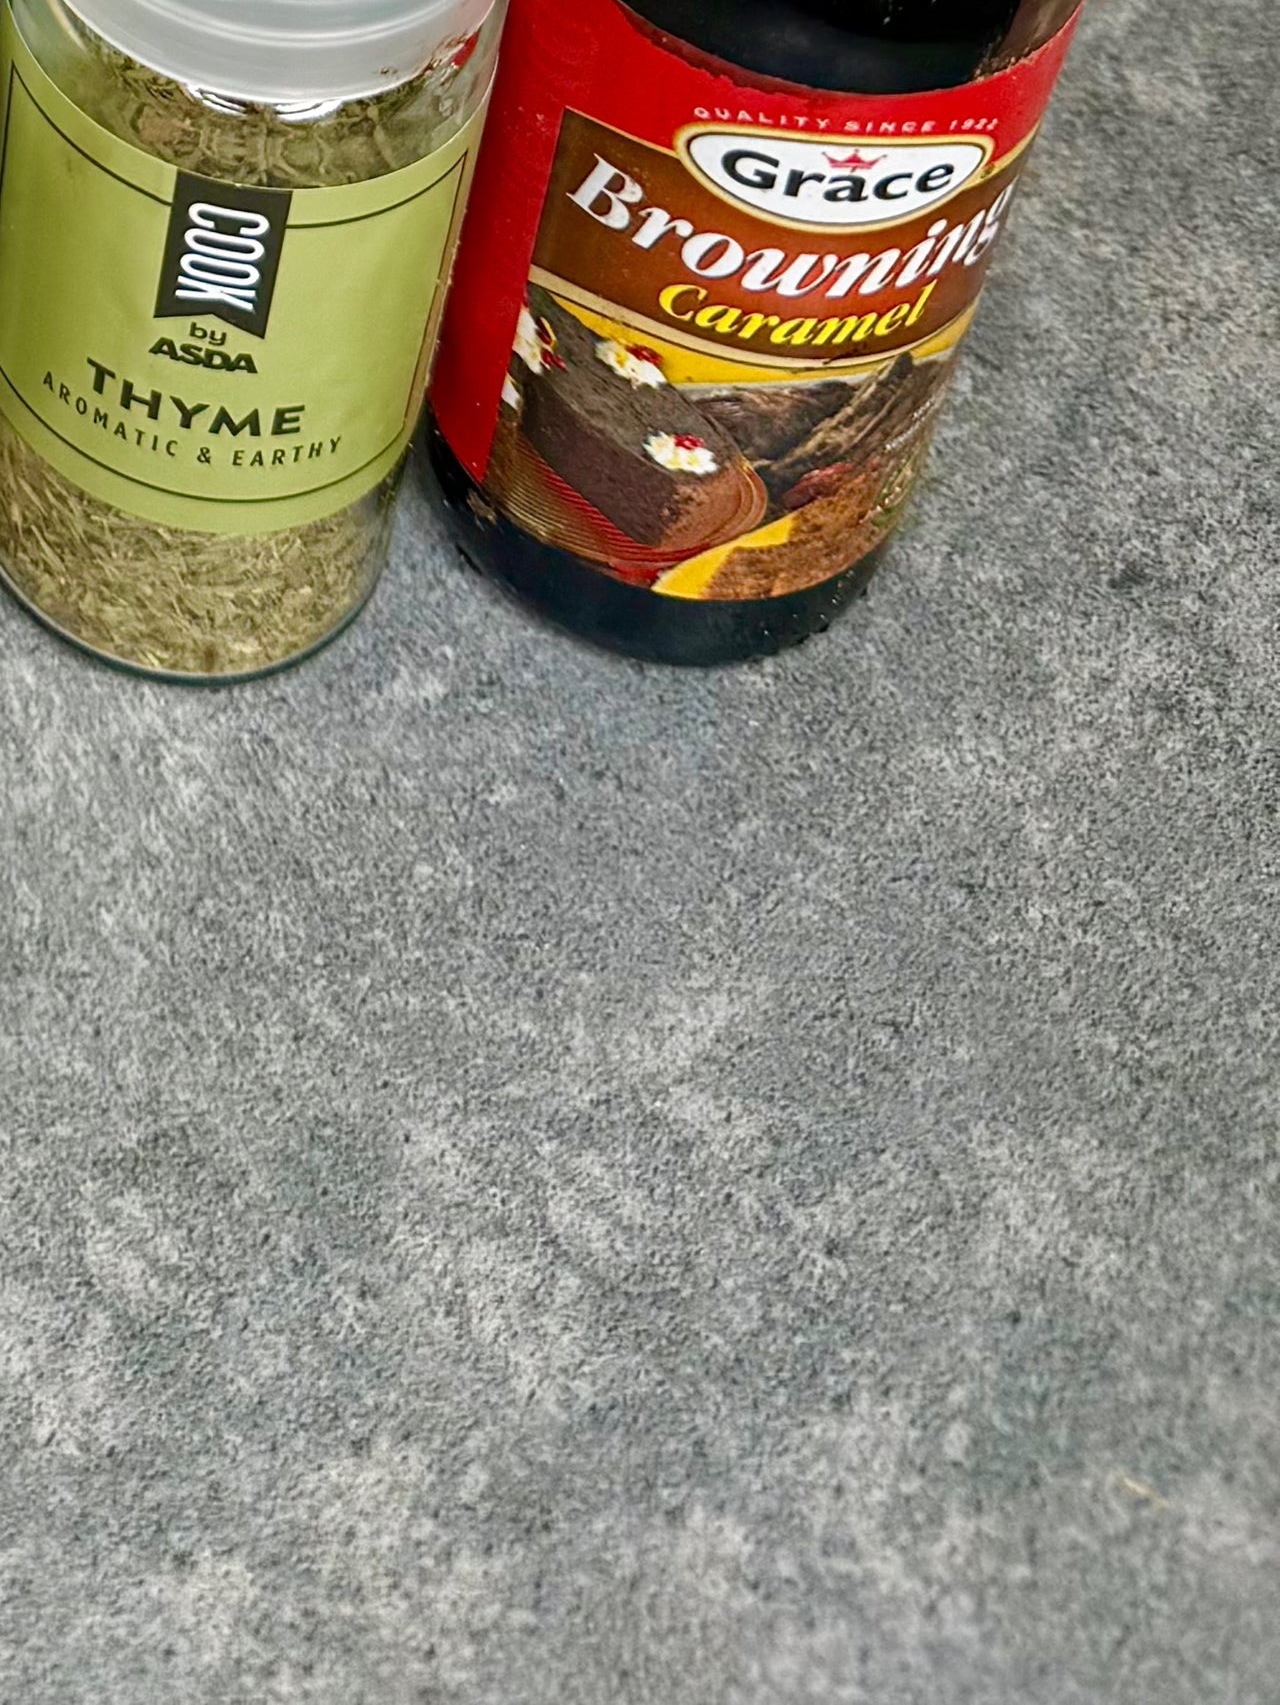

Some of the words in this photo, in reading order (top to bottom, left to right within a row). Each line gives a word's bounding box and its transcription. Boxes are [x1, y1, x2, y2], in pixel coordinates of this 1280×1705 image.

[693, 105, 832, 131] QUALITY
[843, 119, 937, 134] SINCE
[720, 147, 956, 204] Grace
[174, 201, 271, 314] COOK
[565, 152, 1018, 300] Browning
[188, 321, 228, 348] by
[657, 280, 939, 348] Caramel
[148, 335, 259, 375] ASDA
[41, 369, 180, 458] AROMATIC
[195, 445, 214, 466] &
[231, 434, 343, 469] EARTHY
[86, 356, 307, 438] THYME
